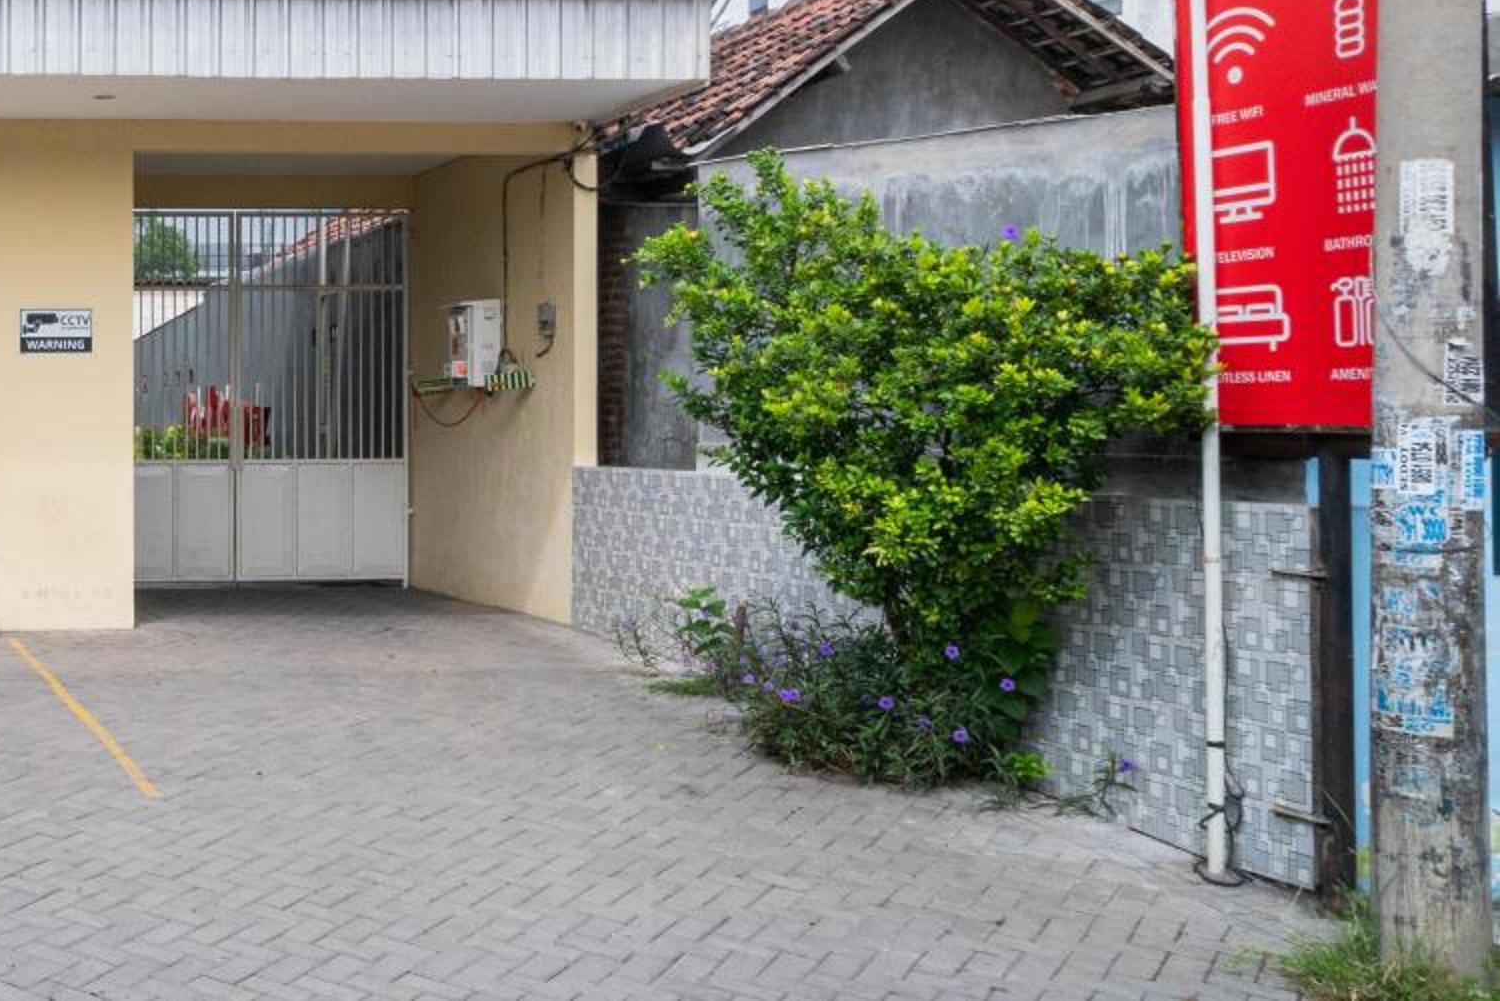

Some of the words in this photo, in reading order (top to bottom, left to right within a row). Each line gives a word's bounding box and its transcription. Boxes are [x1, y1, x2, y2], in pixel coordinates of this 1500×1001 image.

[1304, 85, 1357, 107] MINERAL
[1358, 80, 1377, 94] WA
[1324, 235, 1373, 252] BATHRO
[1218, 247, 1274, 263] ELEVISION
[61, 314, 89, 325] CCTV
[26, 339, 85, 350] WARNING
[1258, 369, 1292, 383] LINEN
